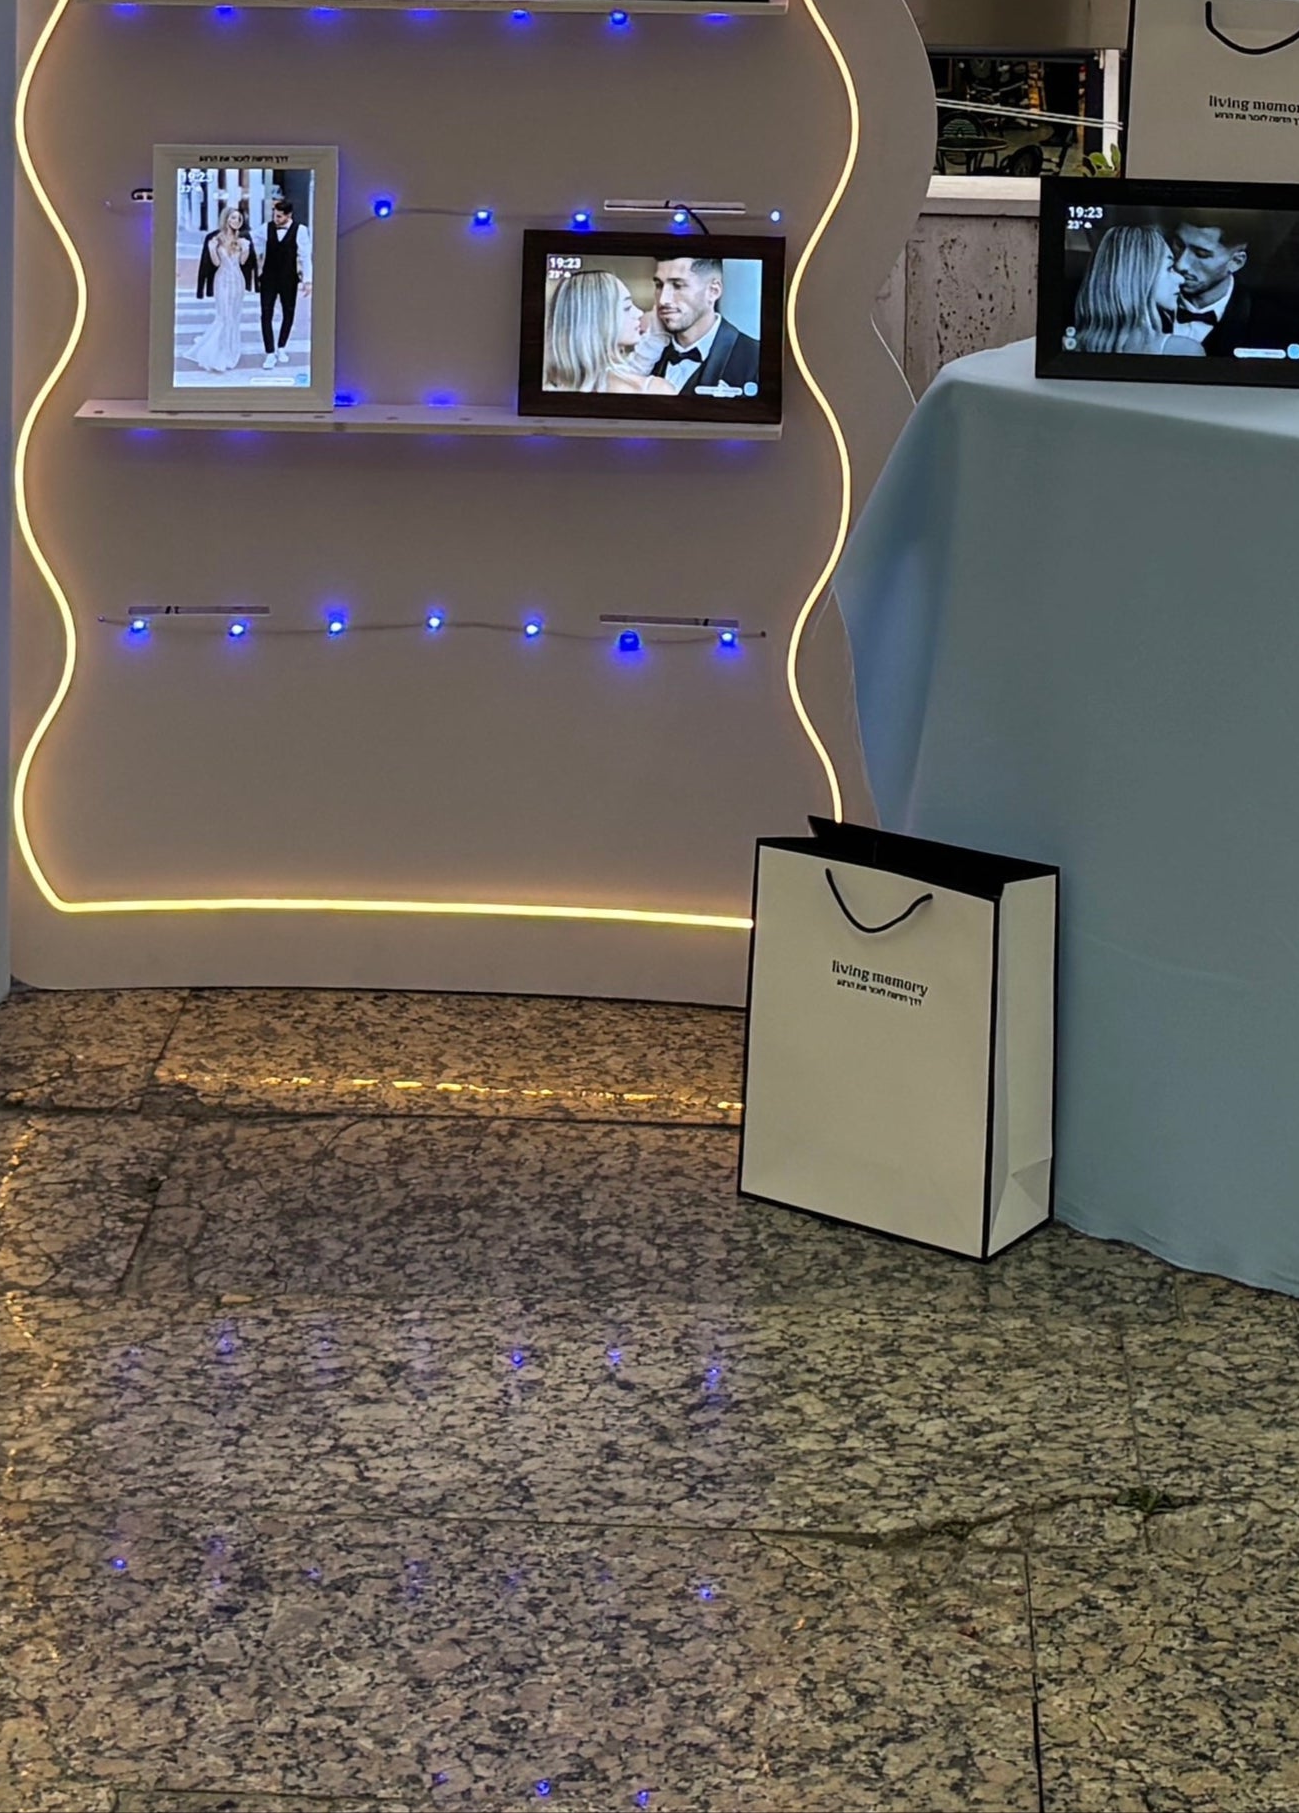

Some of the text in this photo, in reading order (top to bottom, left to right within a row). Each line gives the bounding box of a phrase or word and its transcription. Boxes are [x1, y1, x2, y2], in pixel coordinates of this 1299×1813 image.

[1209, 95, 1250, 112] living
[1068, 206, 1103, 219] 19:23
[550, 257, 581, 269] 19:23
[832, 959, 928, 997] living memory
